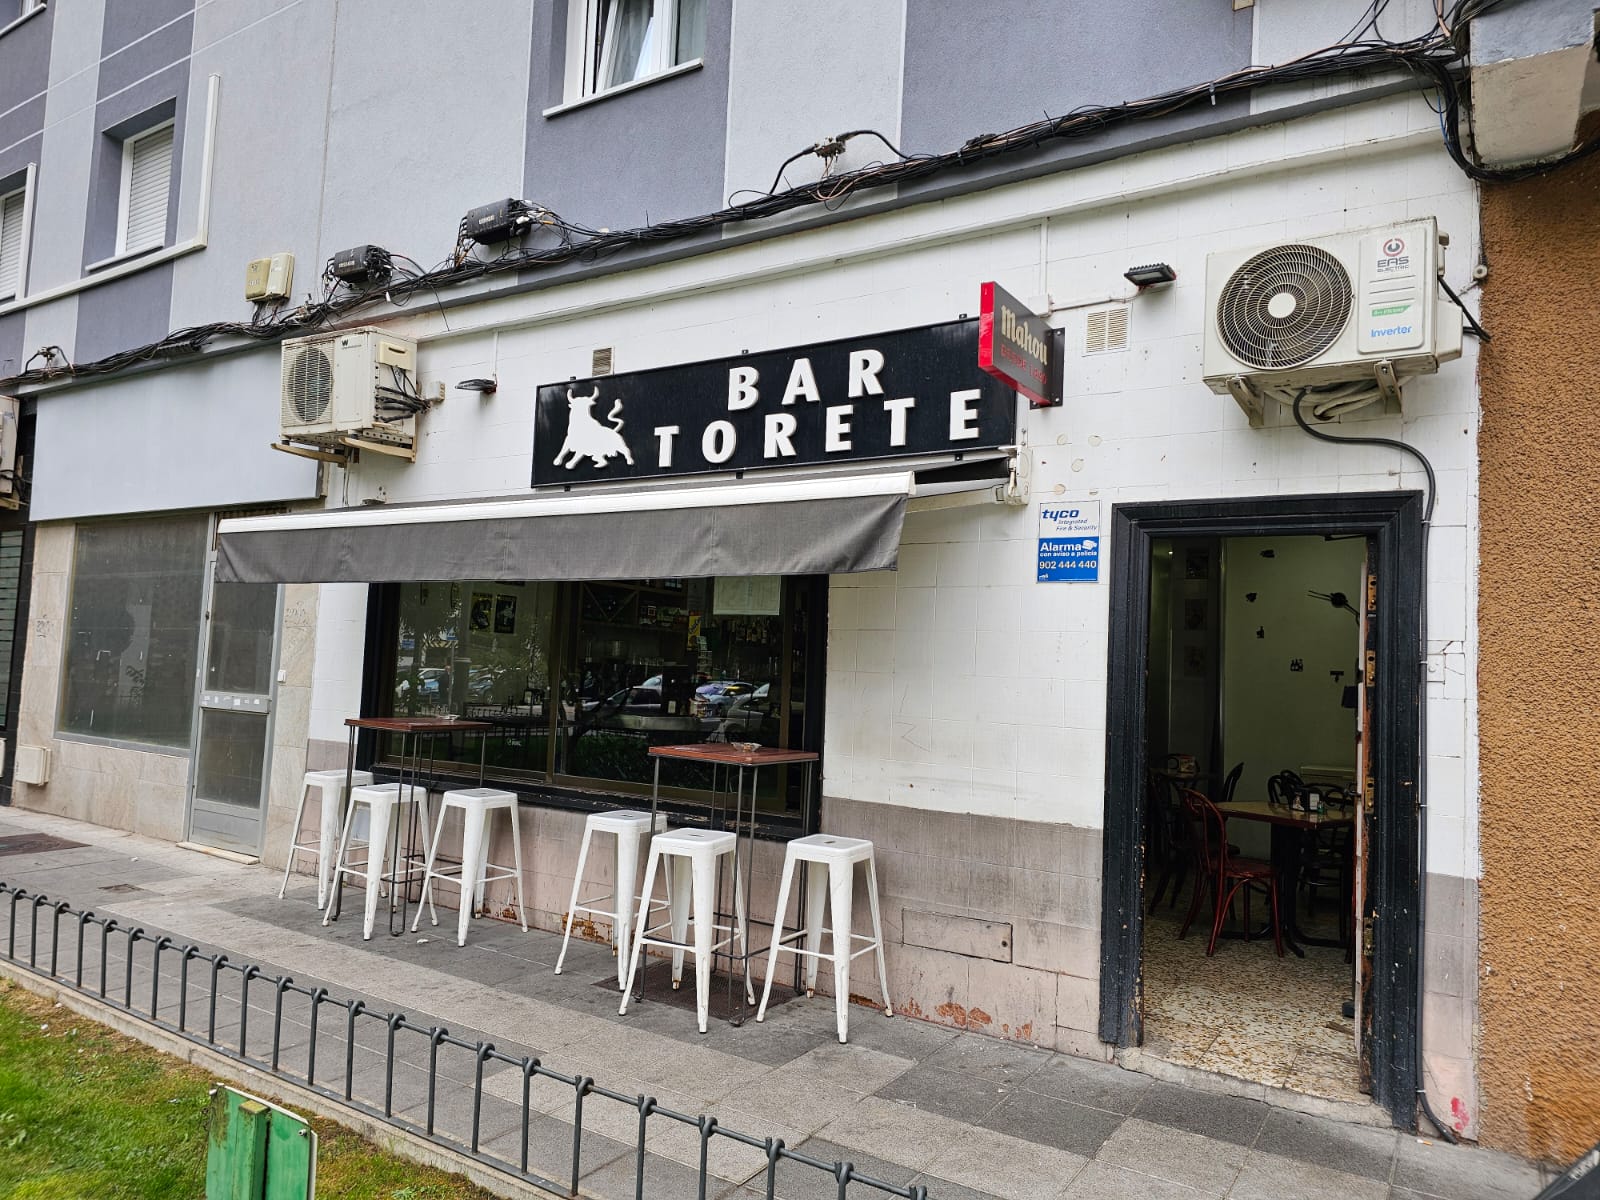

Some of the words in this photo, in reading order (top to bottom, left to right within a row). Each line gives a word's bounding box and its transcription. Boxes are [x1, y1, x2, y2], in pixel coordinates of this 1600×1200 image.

[1377, 256, 1409, 268] EAS
[1001, 304, 1048, 365] Mahou
[1371, 326, 1412, 337] Inverter
[728, 349, 886, 411] BAR
[654, 389, 982, 468] TORETE
[1042, 509, 1079, 521] tyco
[1040, 542, 1081, 551] Alarma
[1039, 561, 1056, 569] 902
[1058, 560, 1076, 569] 444
[1078, 560, 1096, 569] 440
